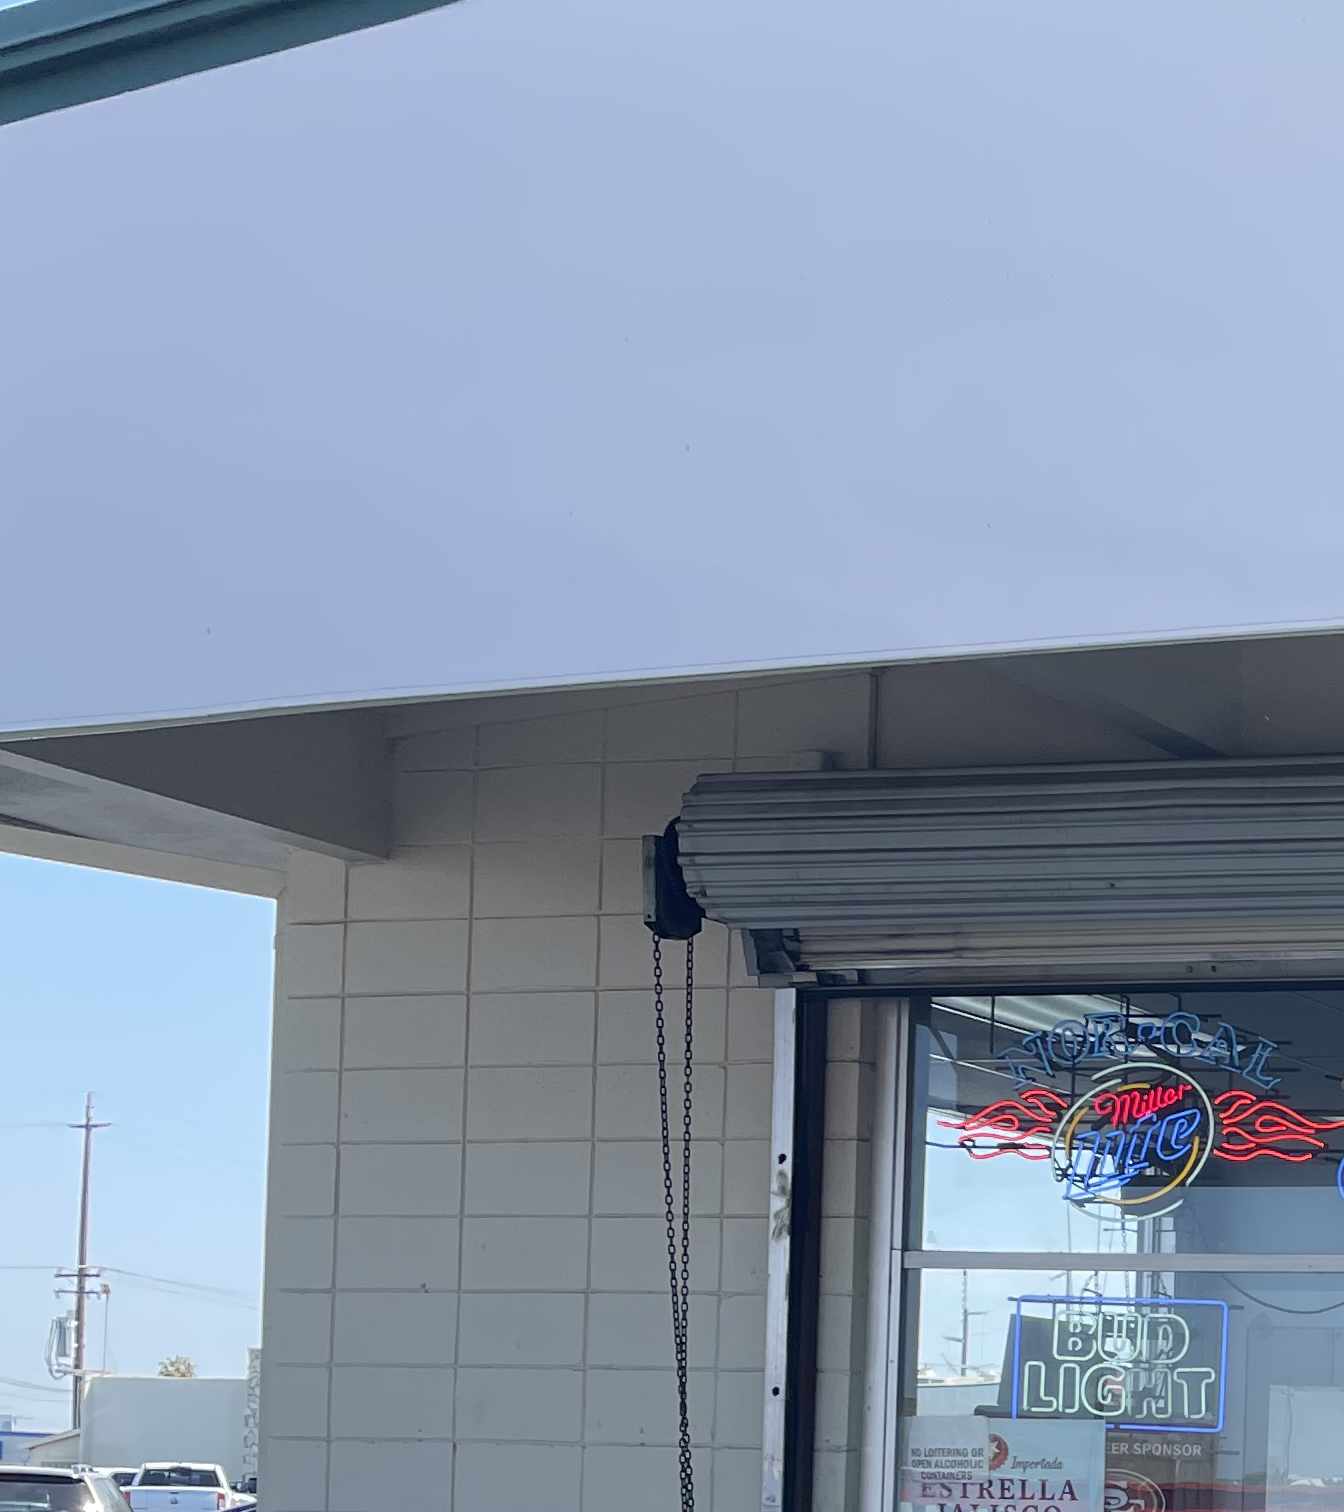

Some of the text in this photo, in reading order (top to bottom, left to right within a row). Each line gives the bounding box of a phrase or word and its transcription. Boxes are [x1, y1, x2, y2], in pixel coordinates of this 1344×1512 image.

[1094, 1084, 1193, 1126] Miller
[1053, 1309, 1190, 1364] BUD
[1023, 1360, 1216, 1419] LIGHT
[923, 1448, 969, 1458] LOITERING
[1133, 1443, 1202, 1456] SPONSOR
[911, 1459, 984, 1469] OPEN ALCOHOLIC
[1011, 1455, 1064, 1473] Importada
[920, 1471, 973, 1480] CONTAINERS
[920, 1478, 1079, 1501] ESTRELLA
